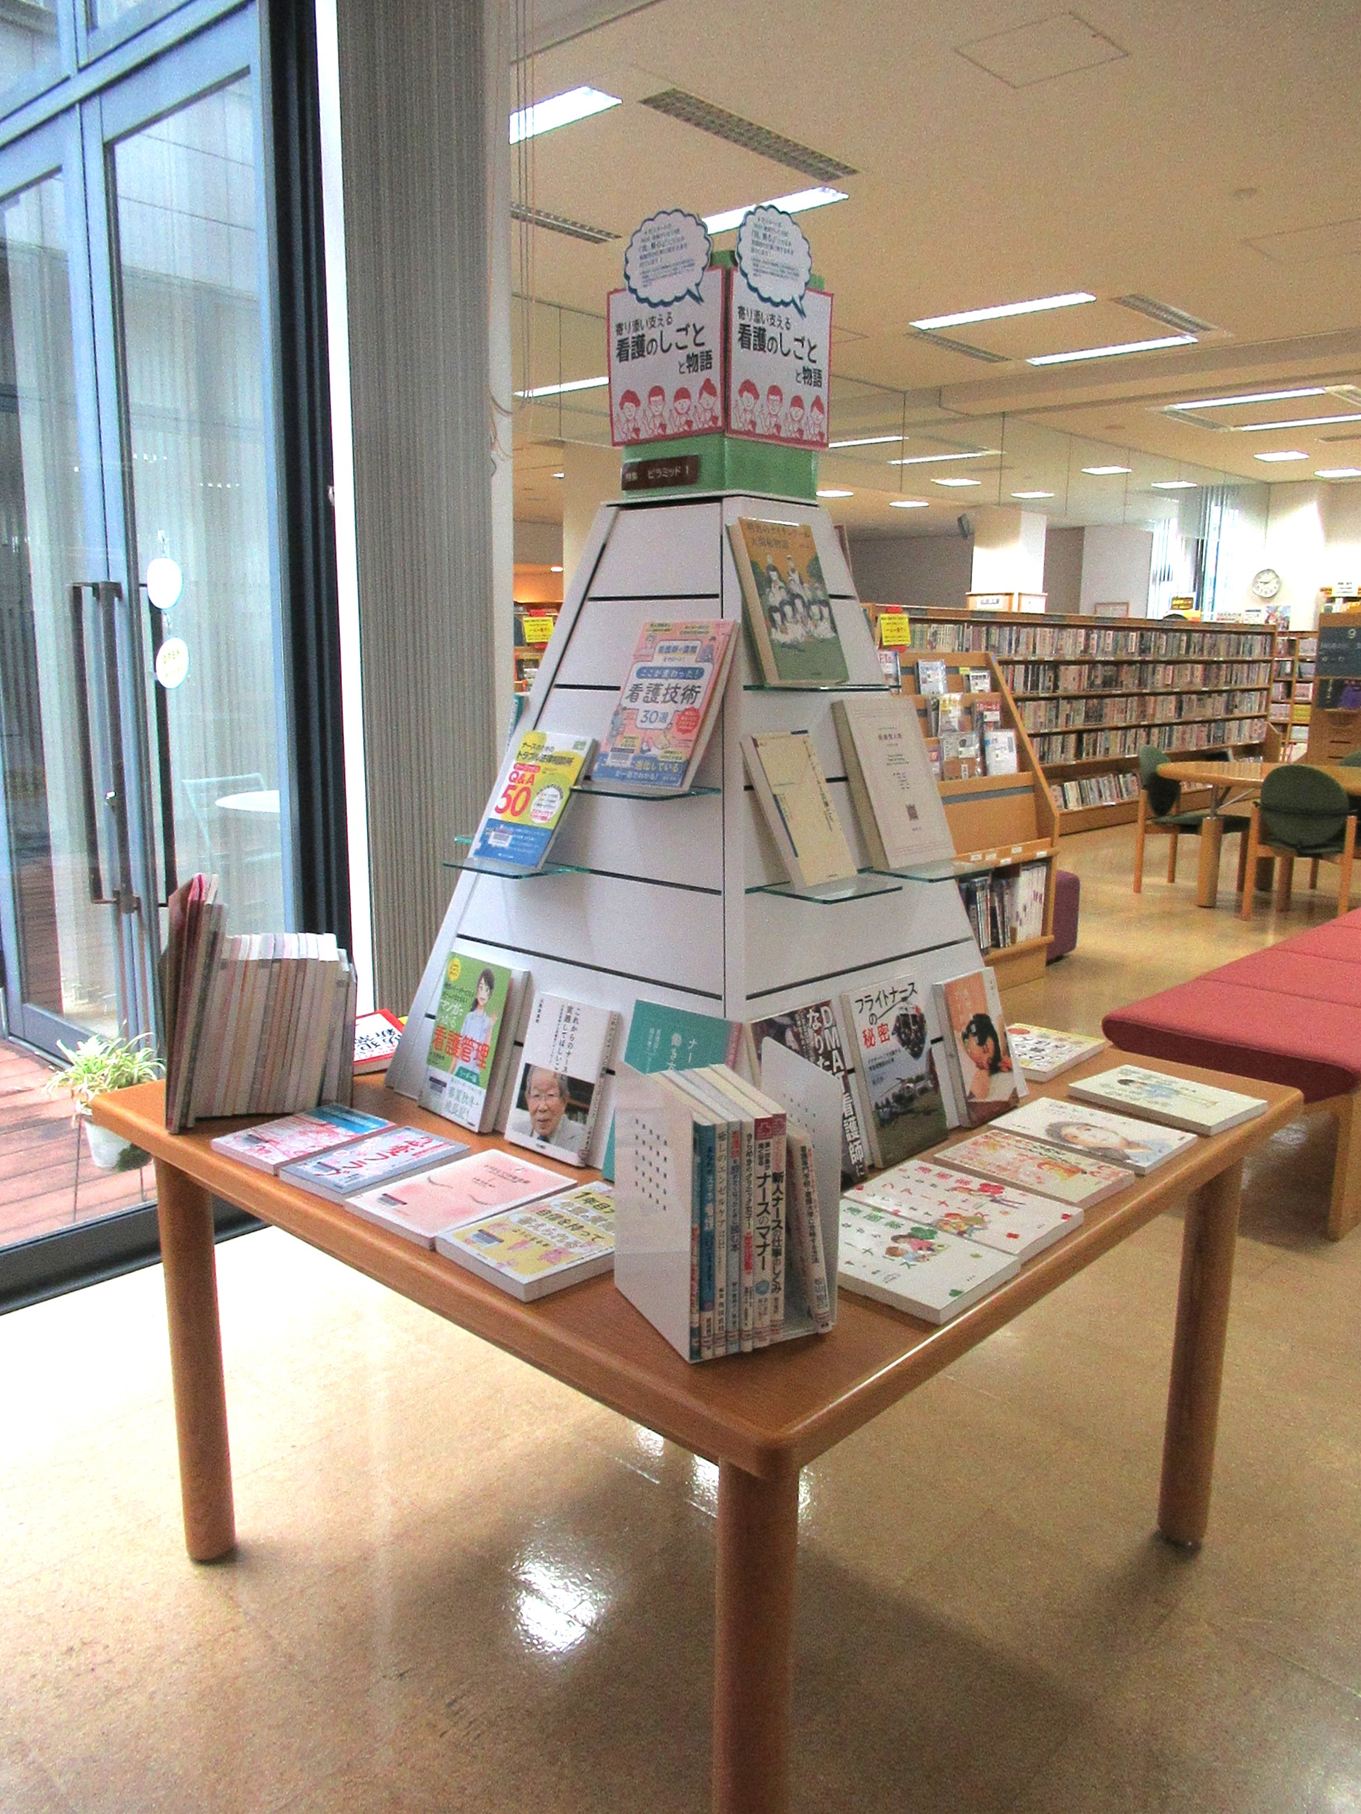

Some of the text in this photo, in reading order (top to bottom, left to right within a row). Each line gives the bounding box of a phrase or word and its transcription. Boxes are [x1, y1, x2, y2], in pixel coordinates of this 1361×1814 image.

[615, 311, 673, 336] 寄り添い支える
[737, 305, 791, 331] 寄り添い支える
[616, 322, 705, 363] 看護のしごと
[738, 323, 817, 364] 看護のしごと
[678, 349, 713, 375] と物語
[795, 366, 822, 388] と物語
[625, 683, 702, 705] 看護技術
[508, 770, 536, 786] Q&A
[494, 784, 532, 817] 50
[855, 982, 918, 1014] フライトナース
[868, 1012, 878, 1026] の
[432, 1024, 490, 1070] 看護管理
[862, 1023, 891, 1049] 秘密
[536, 1208, 605, 1242] 自信を持って
[755, 1172, 771, 1271] ナースのマナー
[771, 1171, 785, 1294] 新人ナースの仕事のしくみ
